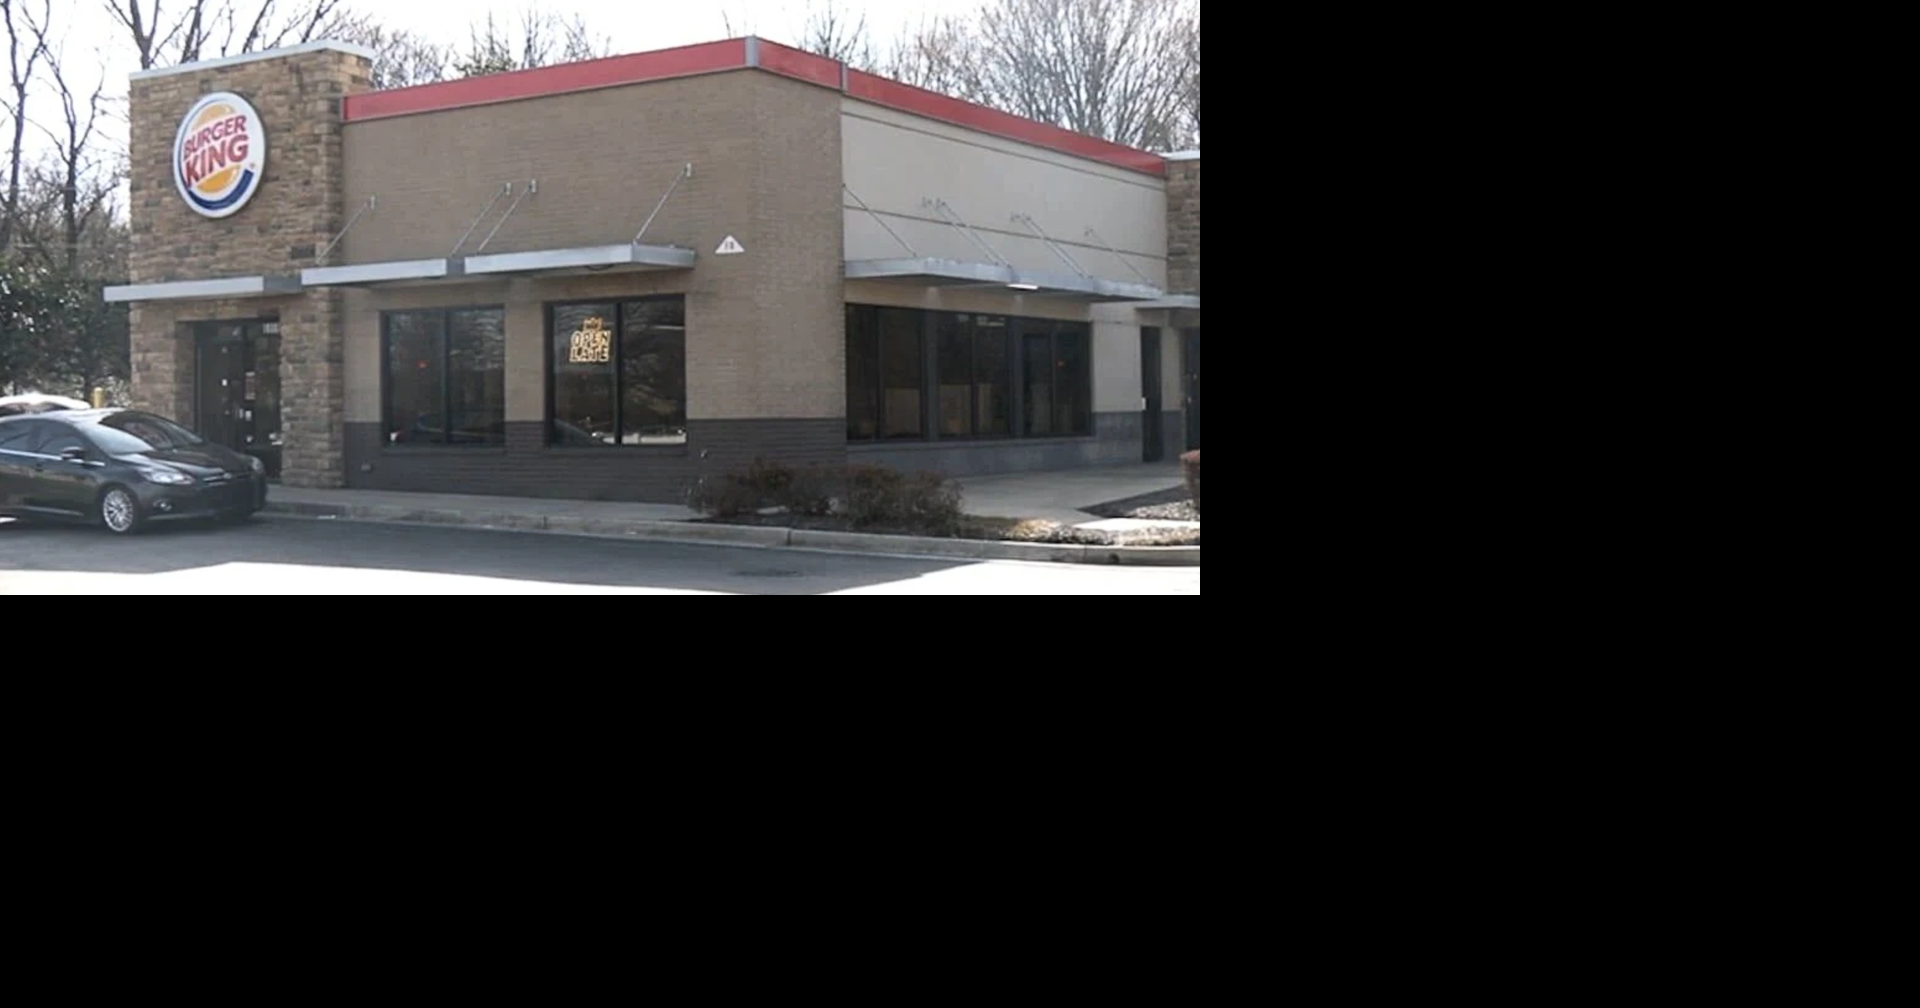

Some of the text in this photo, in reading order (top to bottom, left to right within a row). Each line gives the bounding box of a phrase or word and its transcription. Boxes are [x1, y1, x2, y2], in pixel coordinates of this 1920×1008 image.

[184, 115, 247, 160] BURGER
[185, 135, 248, 188] KING
[570, 346, 609, 362] LATE
[571, 330, 611, 348] OPEN
